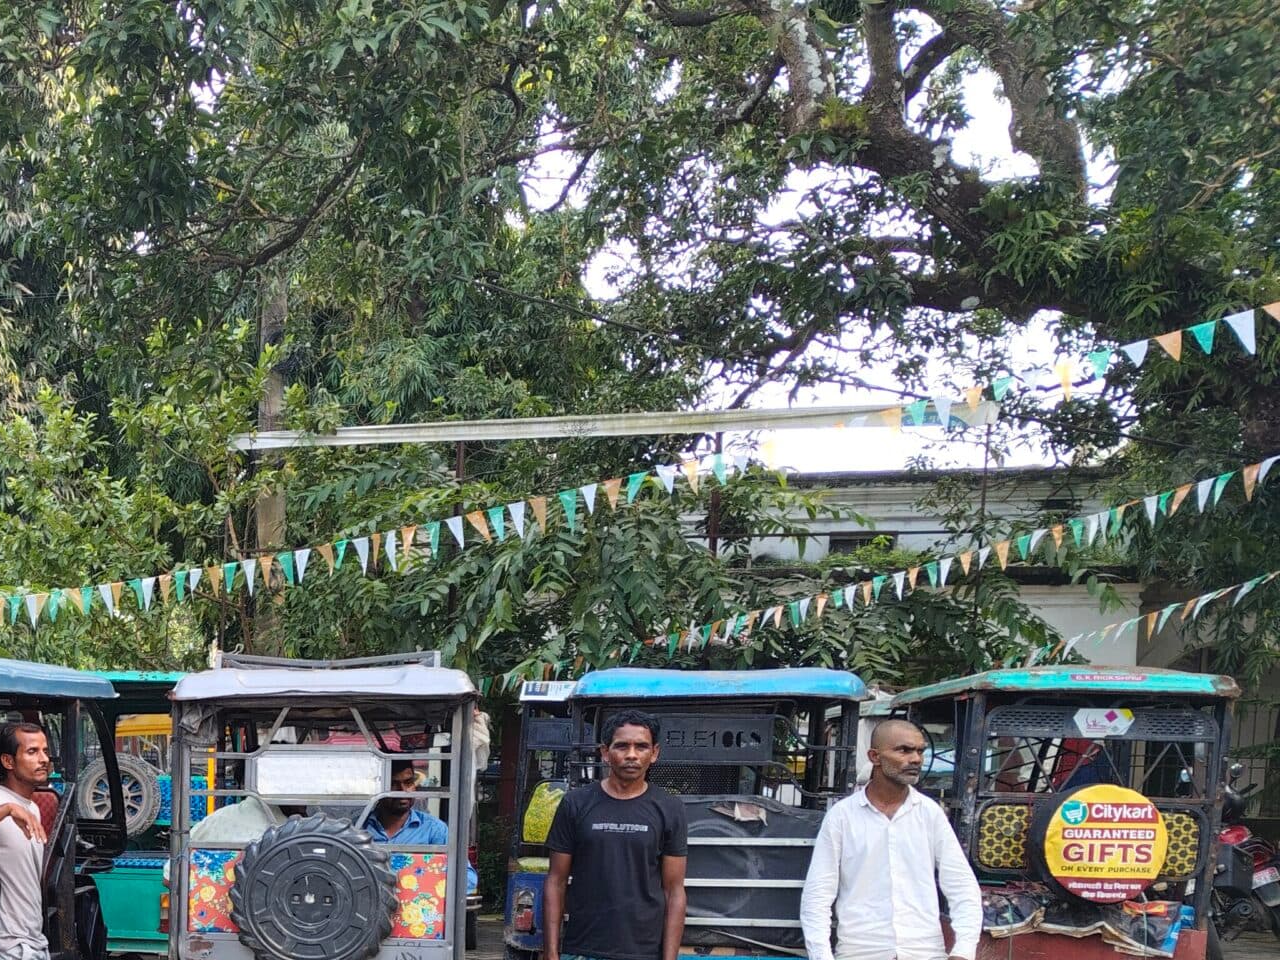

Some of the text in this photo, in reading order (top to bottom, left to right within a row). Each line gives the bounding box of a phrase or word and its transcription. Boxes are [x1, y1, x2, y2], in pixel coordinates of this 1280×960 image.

[1091, 804, 1153, 822] Citykart
[1064, 829, 1155, 839] GUARANTEED
[1062, 843, 1153, 863] GIFTS
[1108, 866, 1152, 874] PURCHASE
